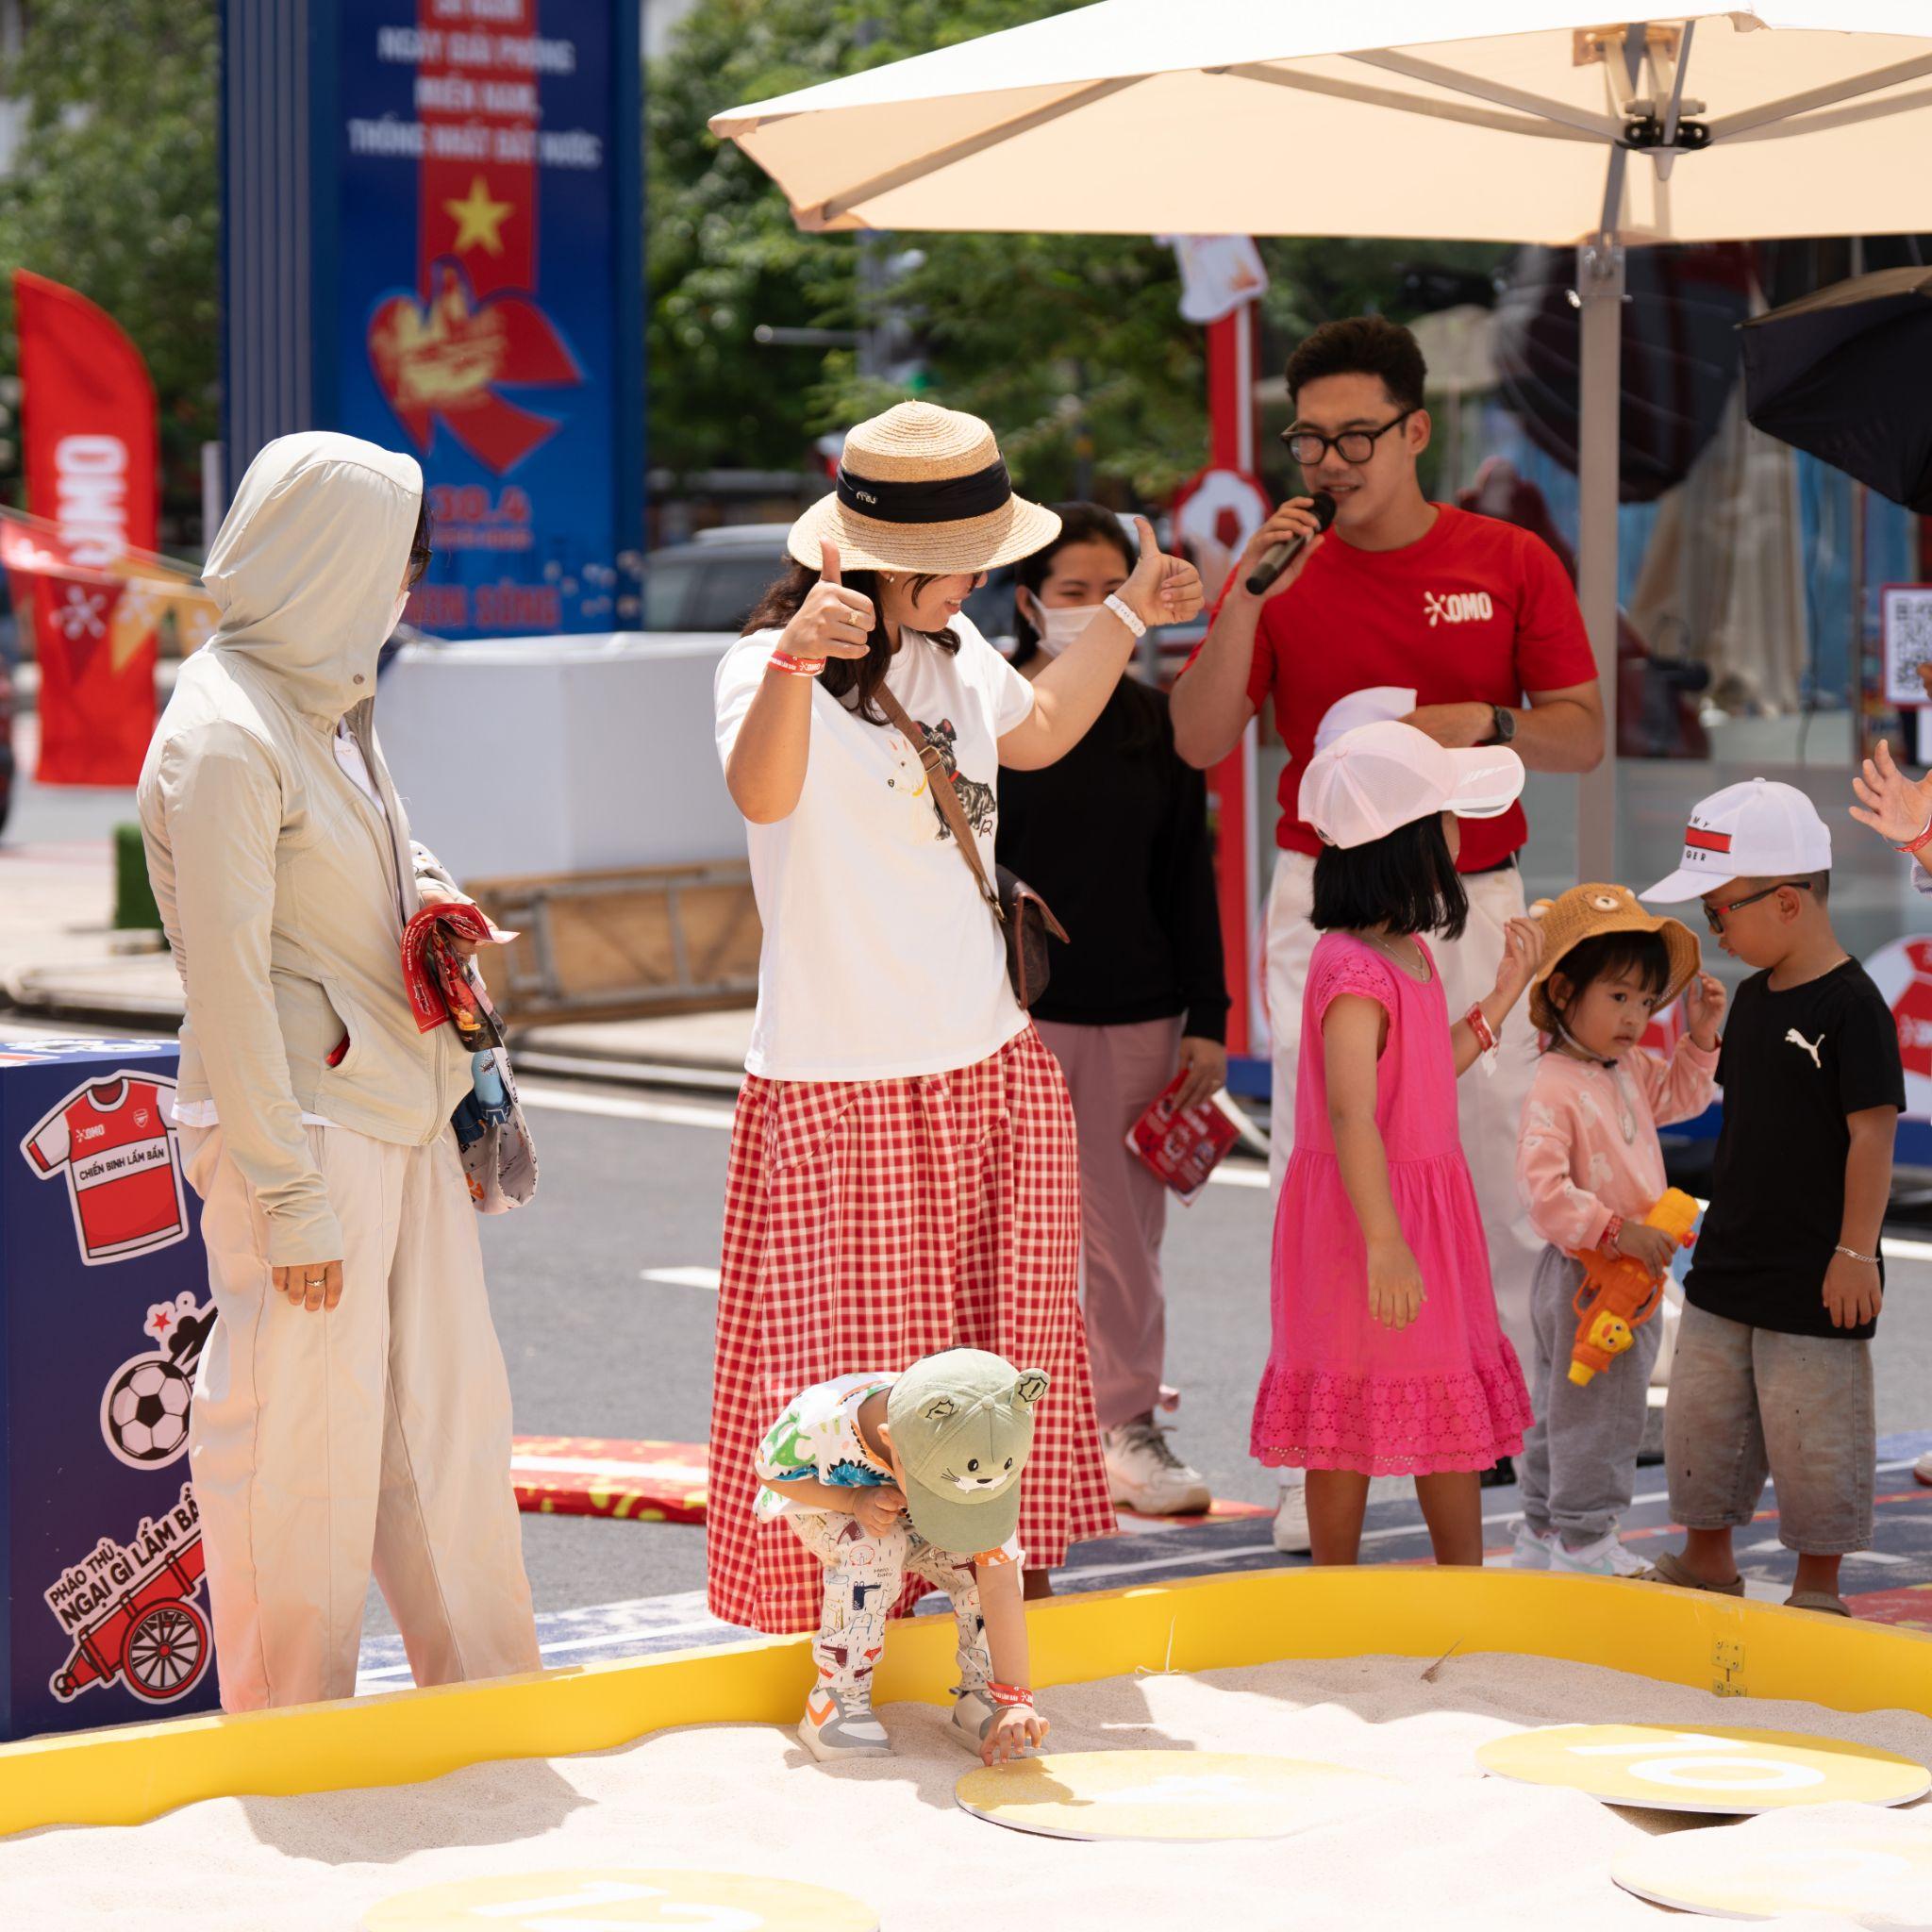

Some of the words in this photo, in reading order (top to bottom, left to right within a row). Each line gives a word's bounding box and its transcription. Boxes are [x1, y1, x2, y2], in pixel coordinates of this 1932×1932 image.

[1447, 591, 1493, 623] OMO
[79, 1160, 105, 1181] CHIẾN
[106, 1157, 125, 1171] BINH
[126, 1148, 145, 1165] LẤM
[49, 1570, 88, 1607] PHÁO
[86, 1541, 117, 1574] THỦ
[58, 1576, 112, 1630] NGẠI
[109, 1551, 136, 1587] GÌ
[130, 1521, 177, 1568] LẤM
[173, 1486, 201, 1533] BẨ
[1564, 1732, 1828, 1790] 10
